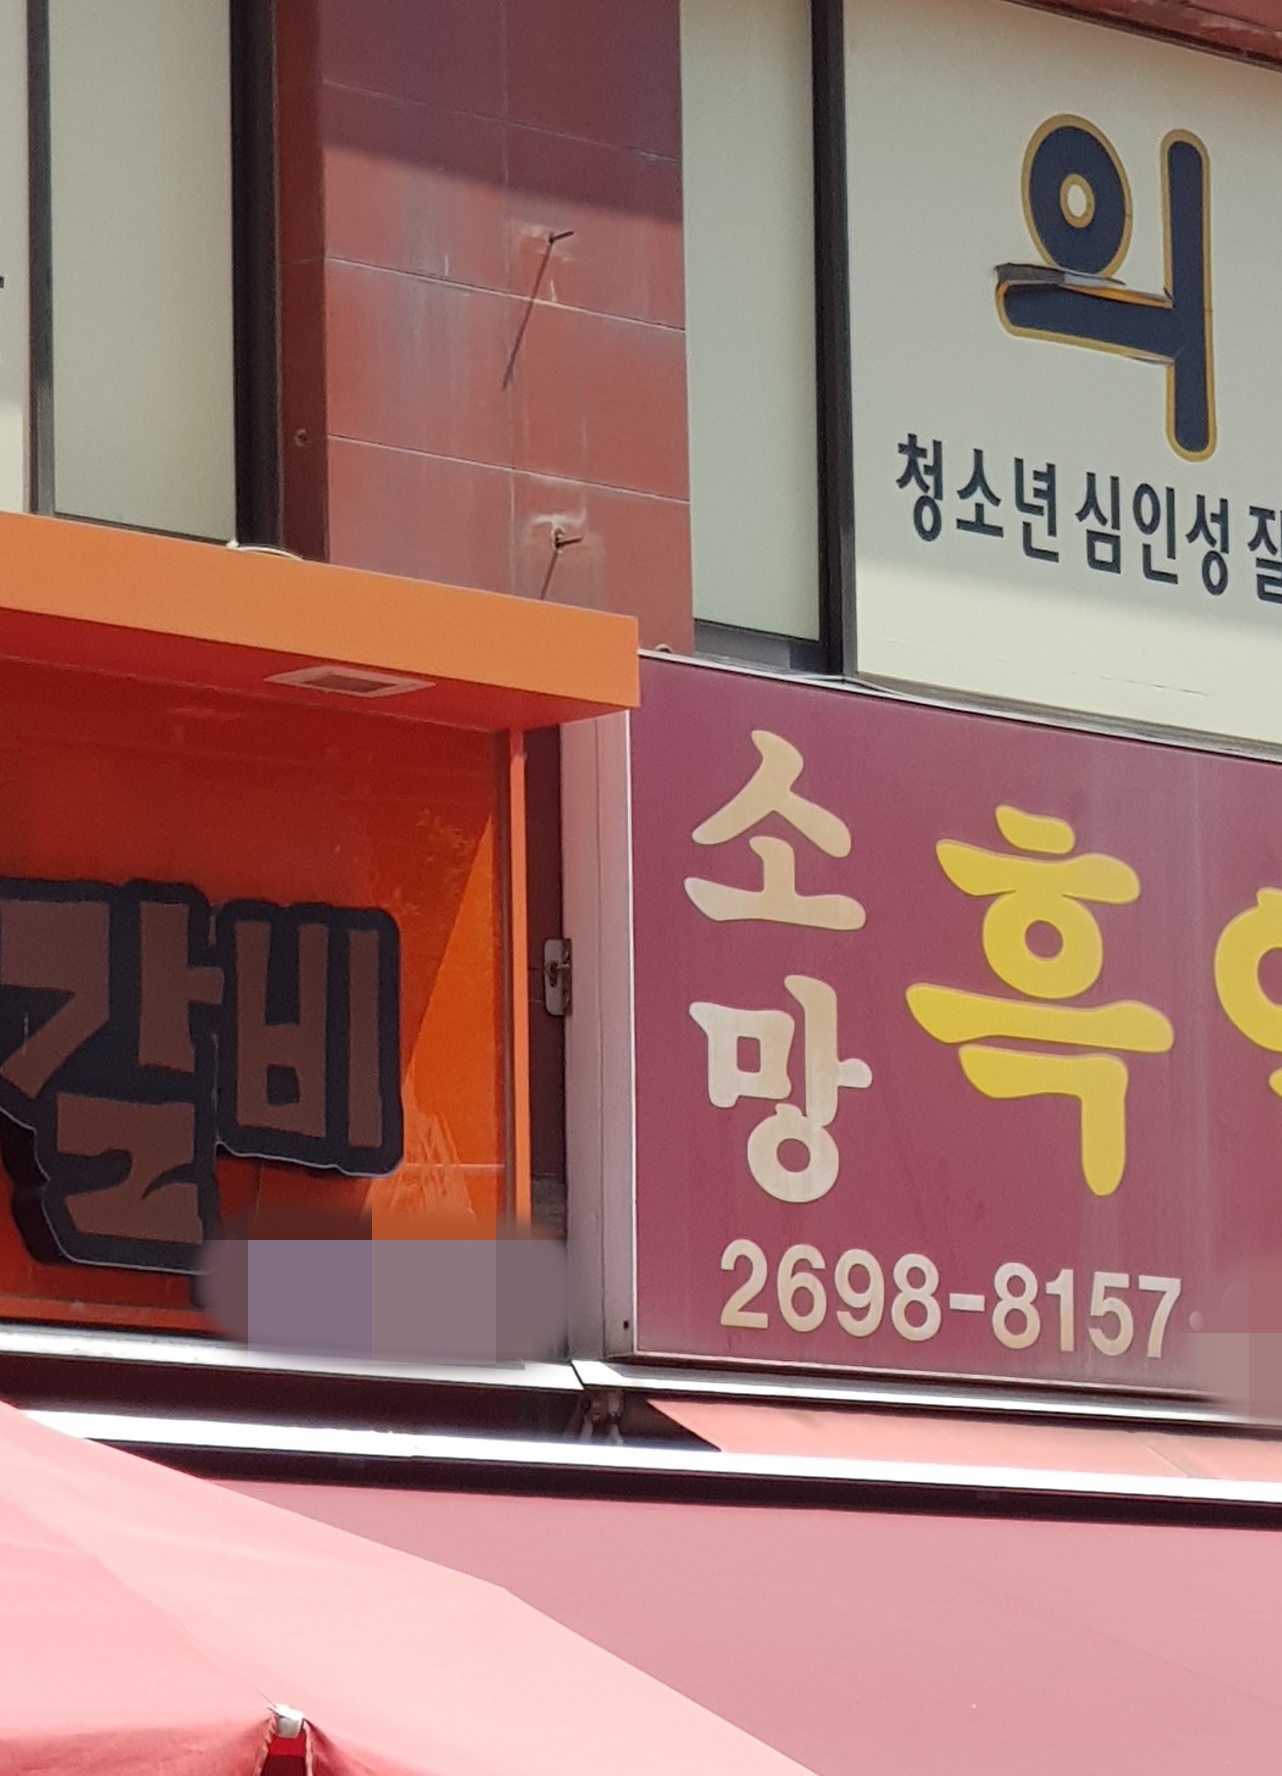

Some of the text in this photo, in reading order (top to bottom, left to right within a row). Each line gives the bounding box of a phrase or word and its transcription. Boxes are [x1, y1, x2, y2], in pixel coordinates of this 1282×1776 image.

[994, 113, 1217, 462] 의
[895, 432, 1060, 564] 청소년
[1075, 471, 1229, 596] 심인성
[719, 1238, 1183, 1359] 2698-8157
